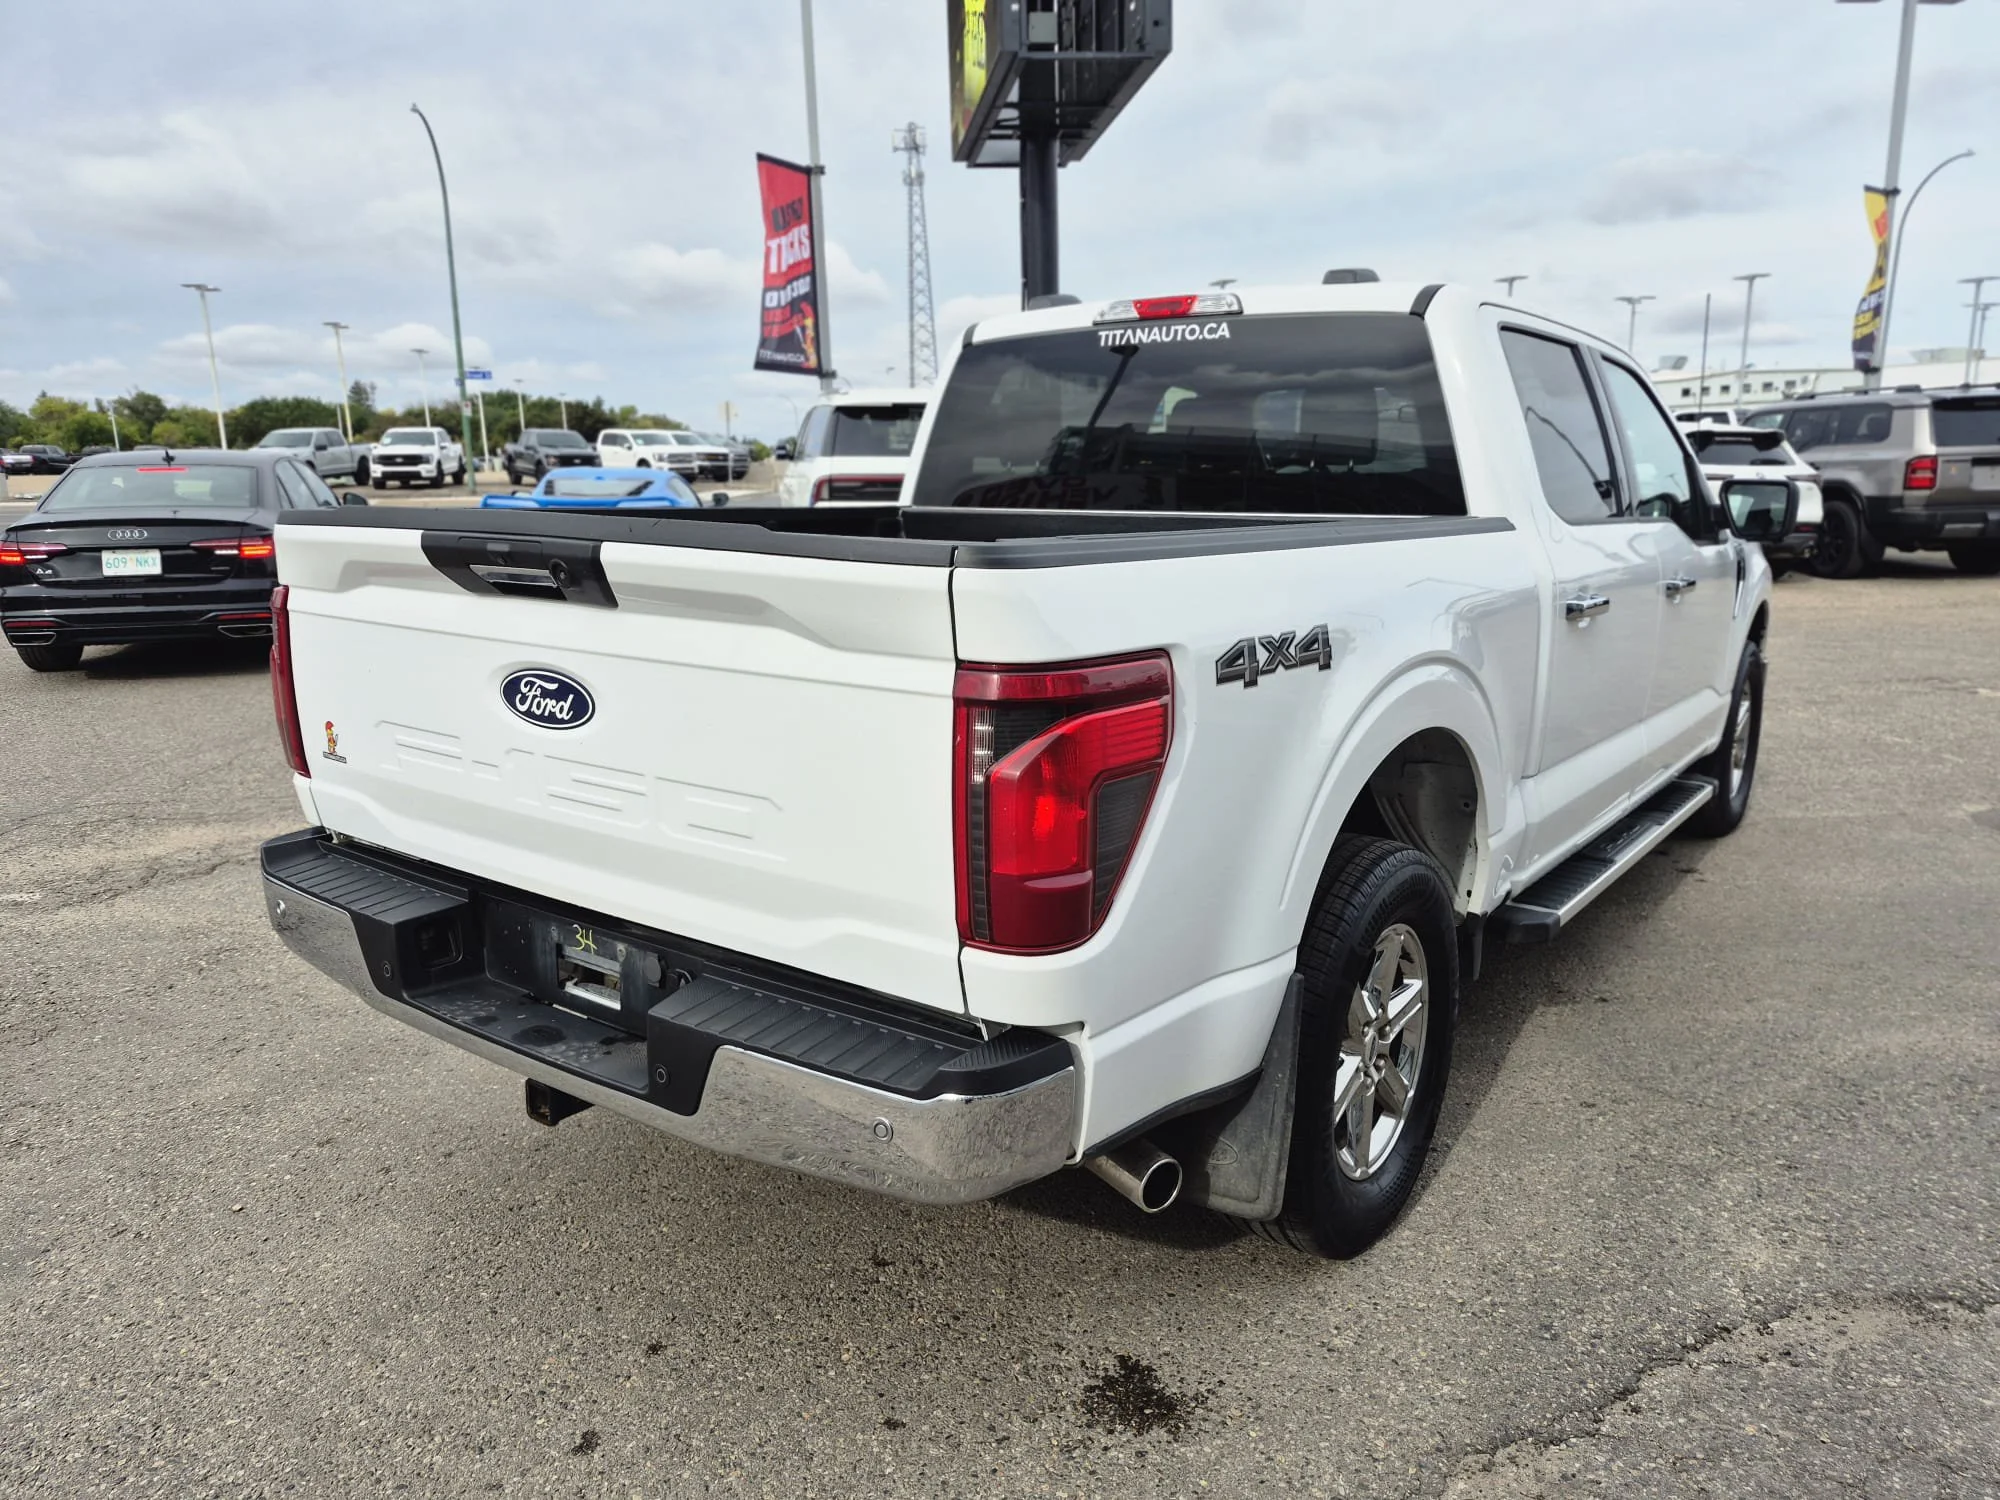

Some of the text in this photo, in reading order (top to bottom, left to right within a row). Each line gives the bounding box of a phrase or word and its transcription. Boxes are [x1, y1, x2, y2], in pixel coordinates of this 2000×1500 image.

[1098, 322, 1230, 347] TITANAUTO.CA
[105, 556, 128, 569] 609
[515, 676, 575, 720] Ford
[571, 924, 598, 955] 34
